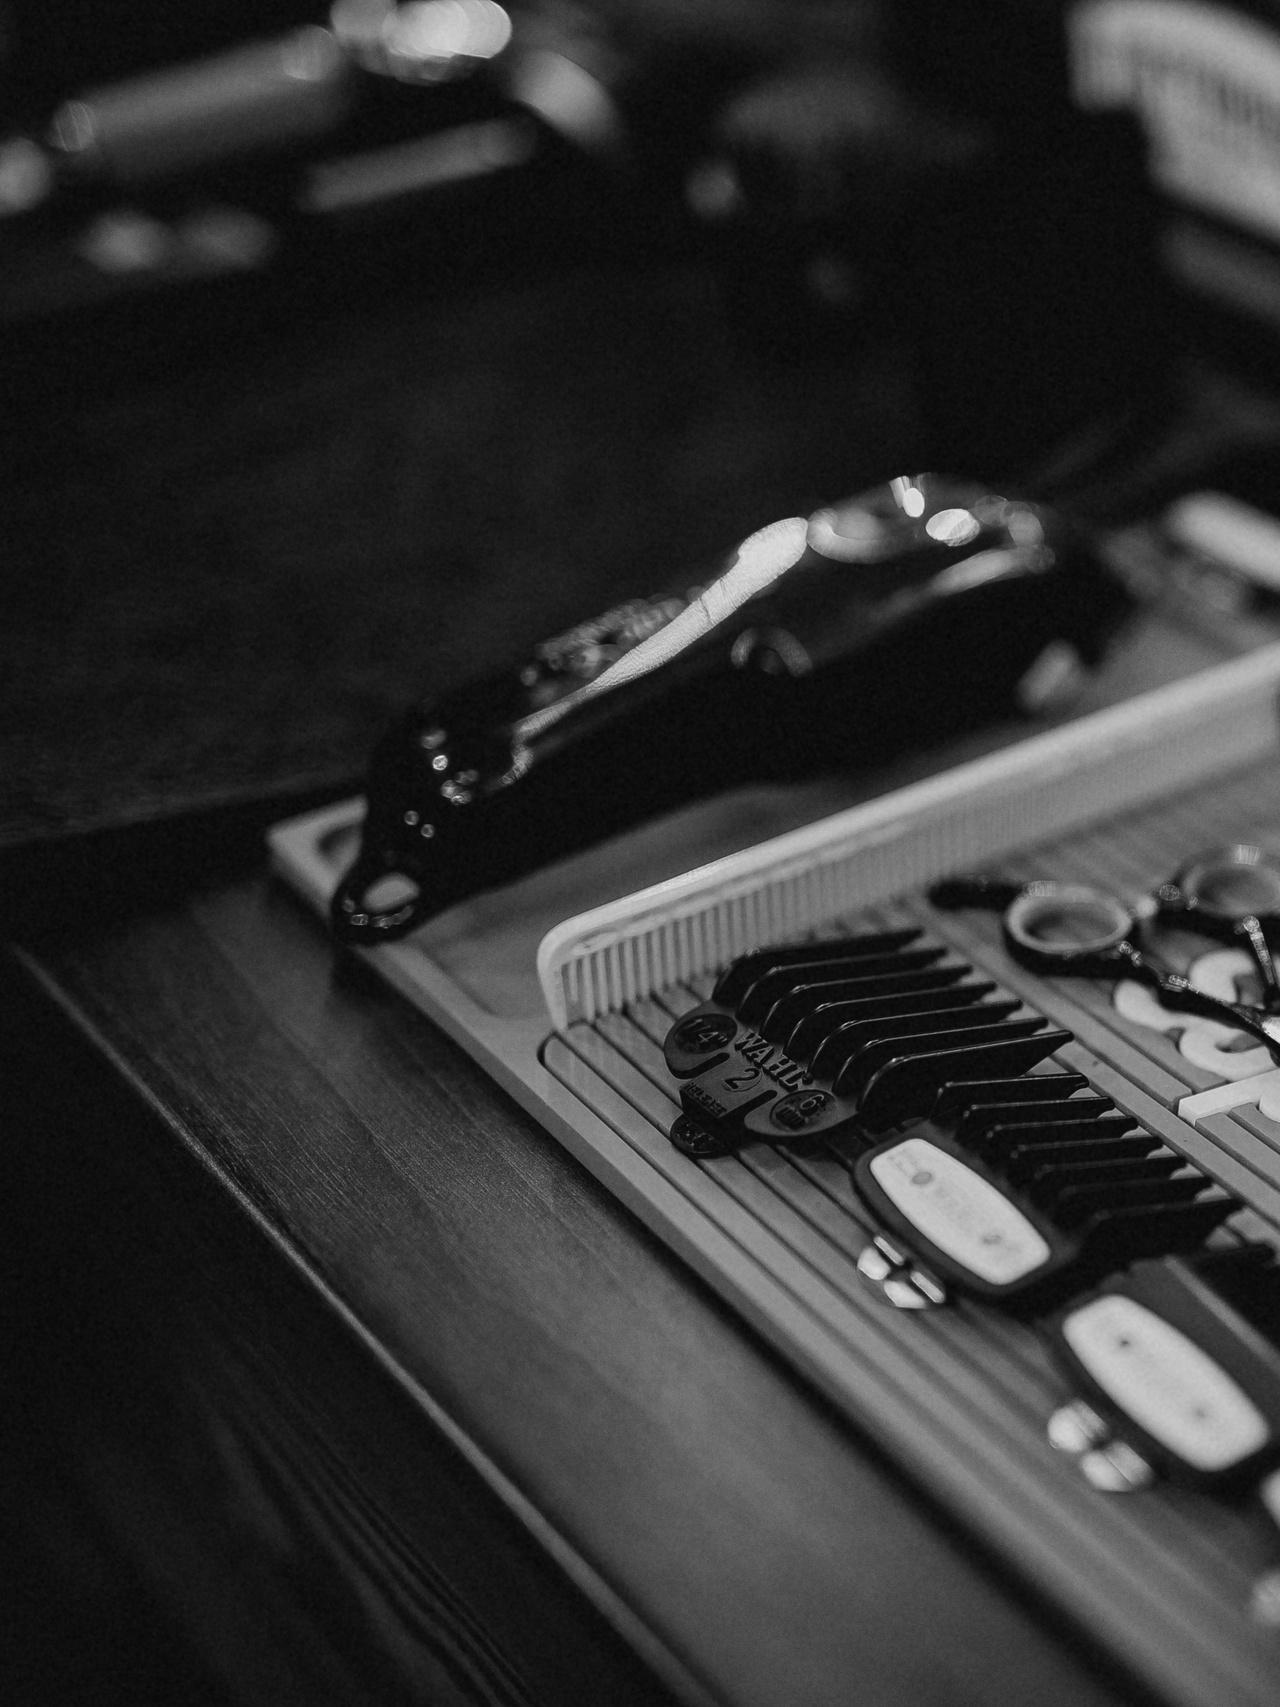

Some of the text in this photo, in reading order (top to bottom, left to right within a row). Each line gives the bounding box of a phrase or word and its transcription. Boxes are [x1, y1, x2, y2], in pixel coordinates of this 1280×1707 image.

[735, 1028, 808, 1088] WAHL
[722, 1066, 761, 1090] 2
[681, 1082, 728, 1116] RELEASE
